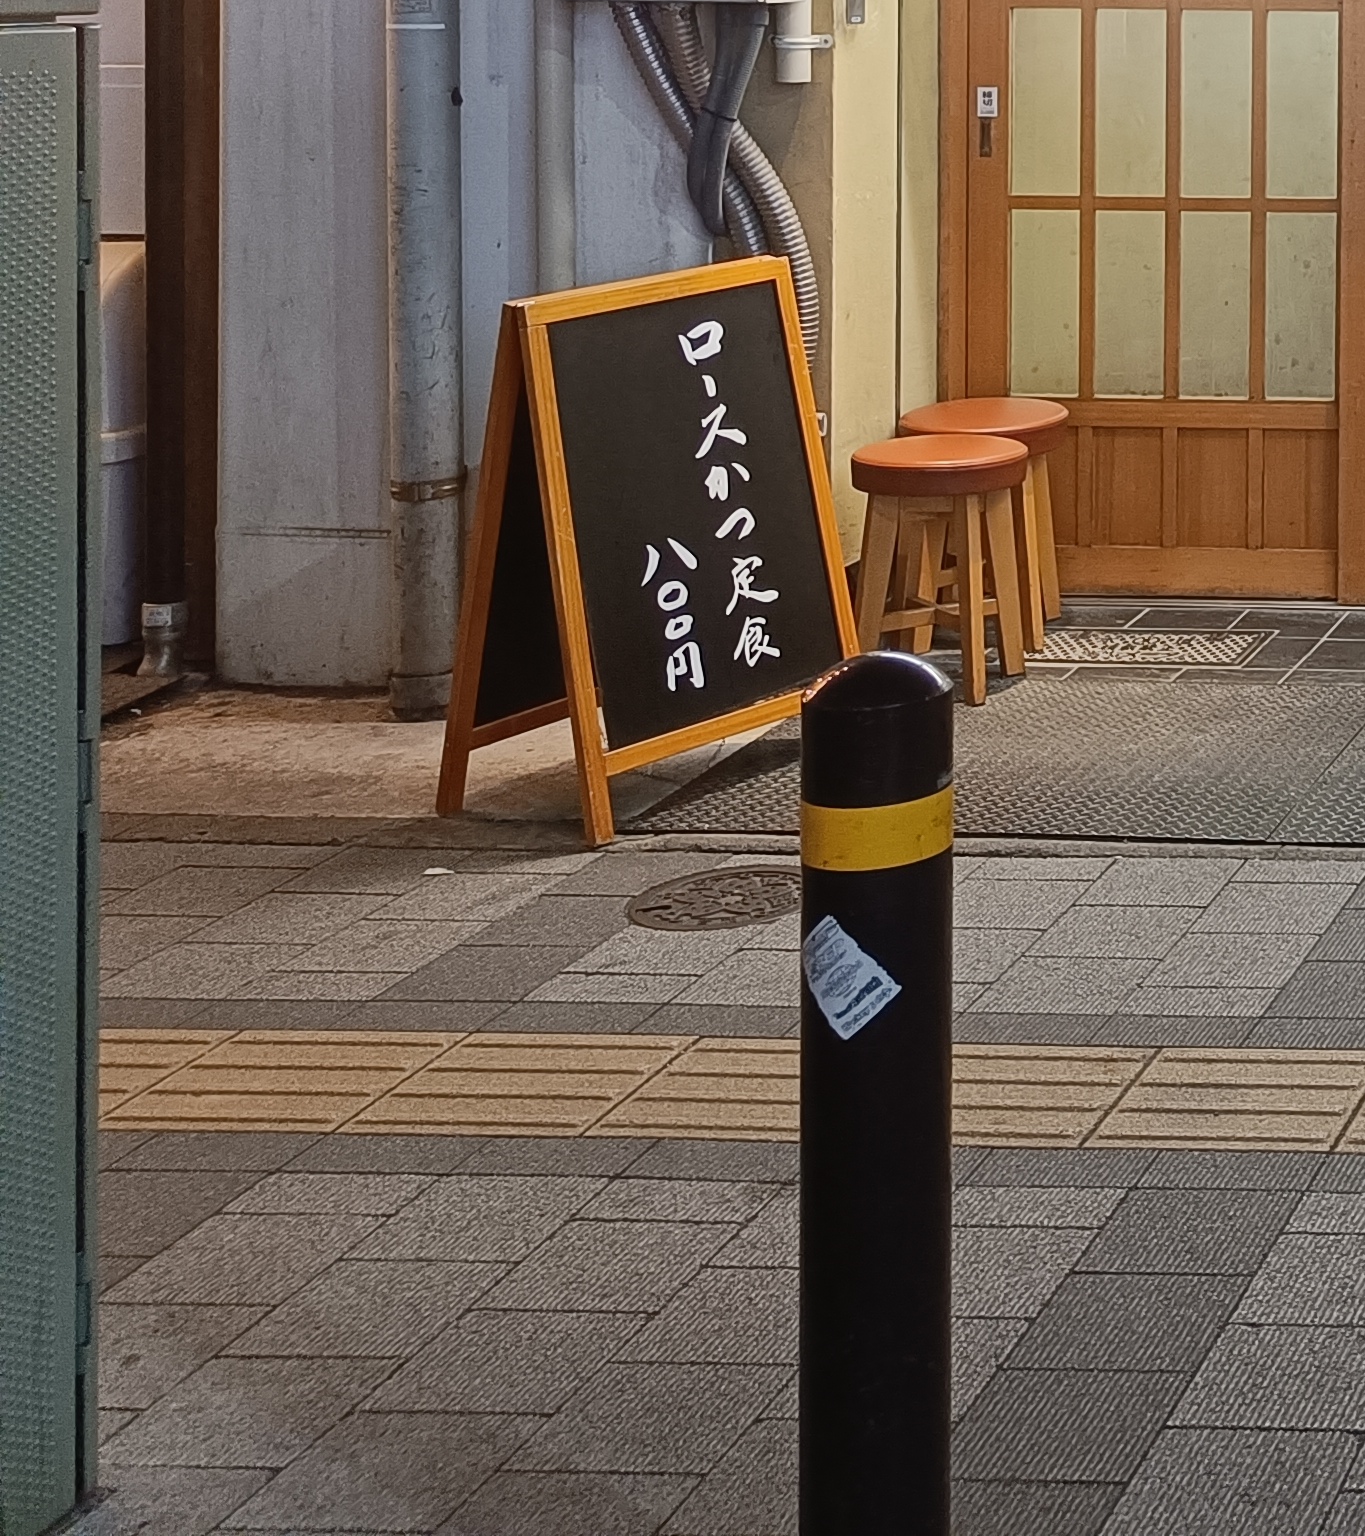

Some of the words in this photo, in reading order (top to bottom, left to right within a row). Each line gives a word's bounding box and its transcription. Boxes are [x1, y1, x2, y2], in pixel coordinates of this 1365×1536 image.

[677, 319, 781, 669] ロースかつ定食
